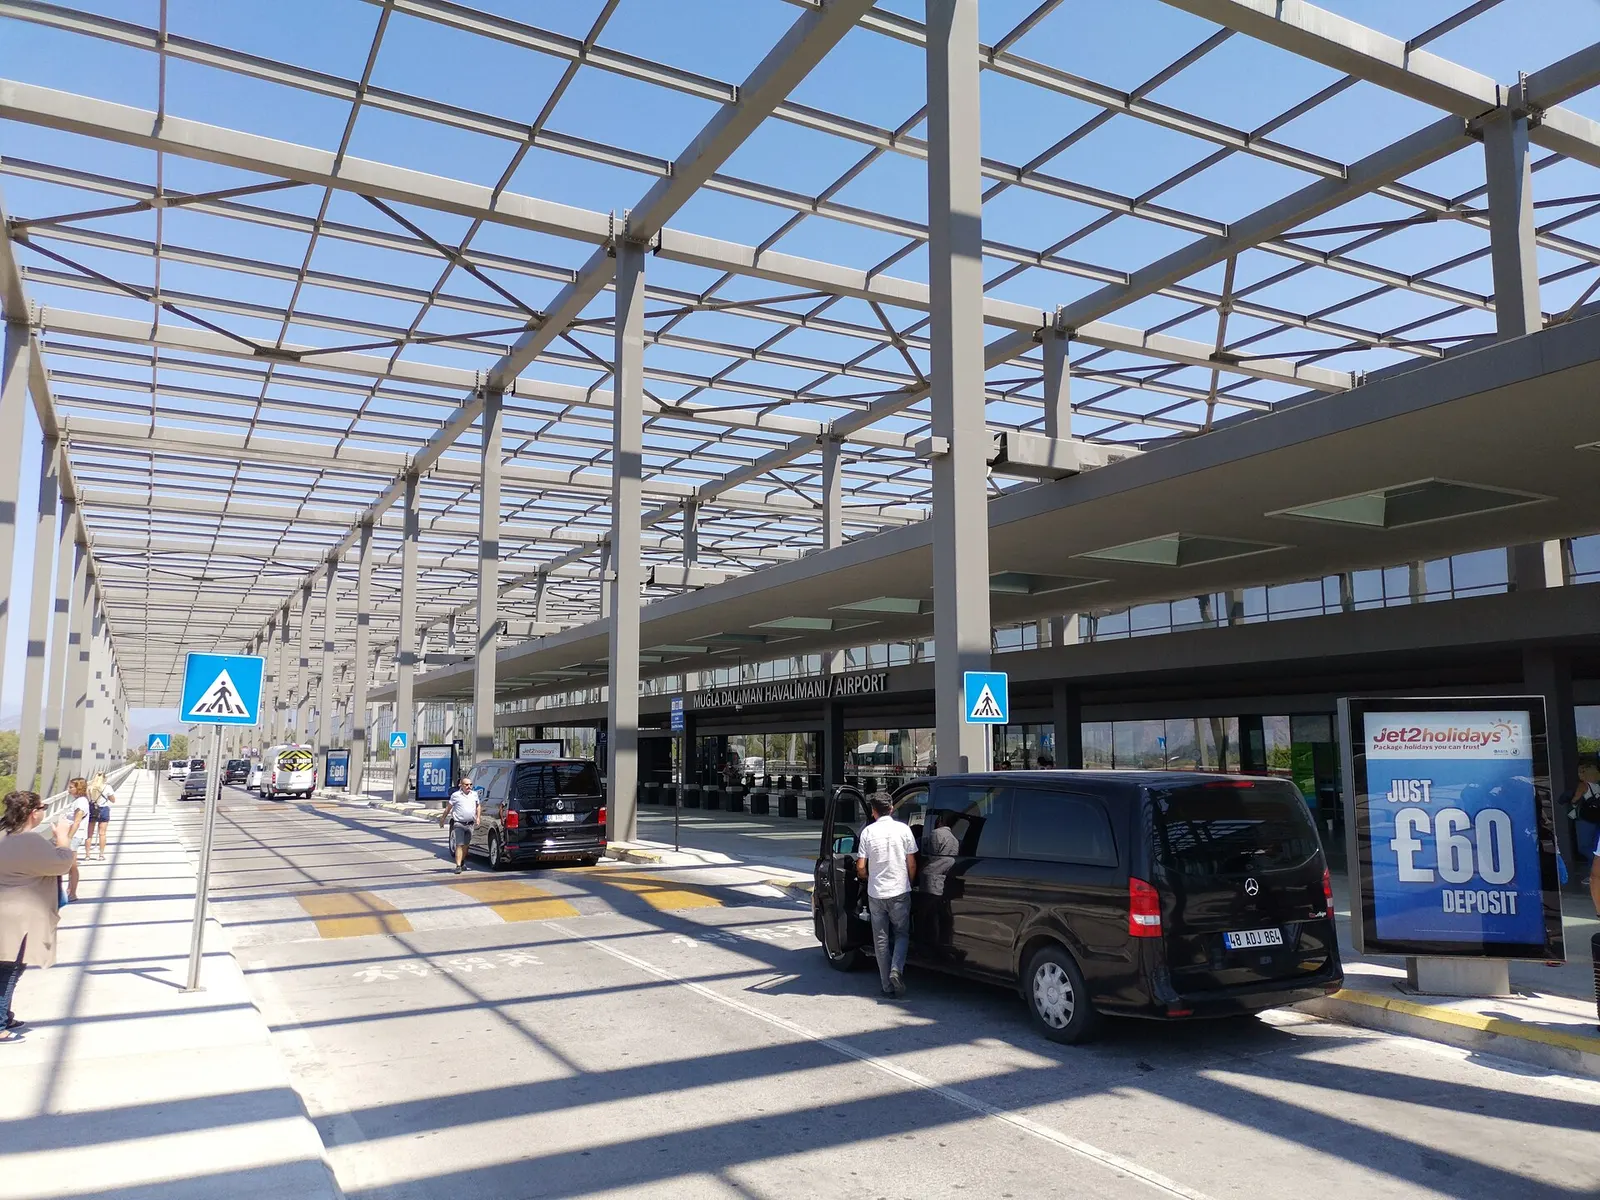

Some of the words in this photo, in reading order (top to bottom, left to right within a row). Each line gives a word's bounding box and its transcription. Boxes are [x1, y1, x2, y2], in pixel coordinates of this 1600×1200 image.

[693, 689, 721, 708] MUĞLA
[722, 689, 763, 706] DALAMAN
[765, 680, 825, 702] HAVALİMANI
[835, 673, 886, 696] AIRPORT
[1373, 727, 1501, 746] Jet2holidays
[423, 768, 446, 786] £60
[1386, 779, 1432, 803] JUST
[1390, 807, 1515, 885] £60
[1442, 889, 1518, 915] DEPOSIT
[1230, 933, 1242, 947] 48
[1245, 932, 1262, 945] ADJ
[1264, 930, 1281, 943] 864
